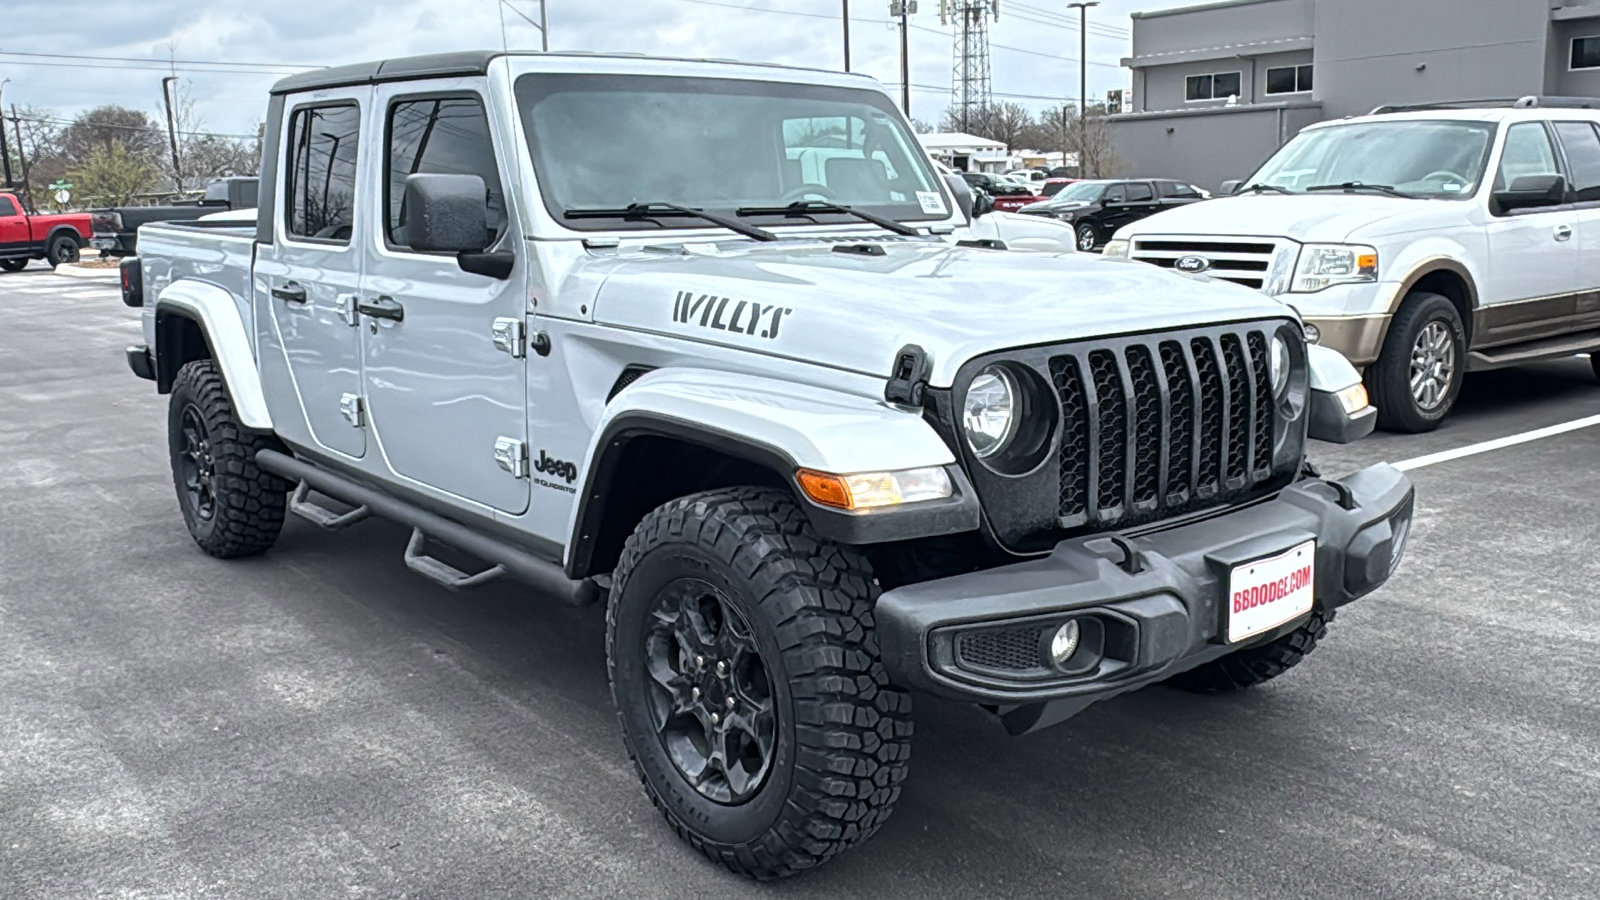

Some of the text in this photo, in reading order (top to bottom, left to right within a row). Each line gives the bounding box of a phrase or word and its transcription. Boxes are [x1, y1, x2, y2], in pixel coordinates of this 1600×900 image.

[1180, 258, 1200, 269] Ford
[672, 290, 793, 339] WILLYS
[534, 449, 577, 484] Jeep
[1233, 565, 1311, 614] BBDODGE.COM
